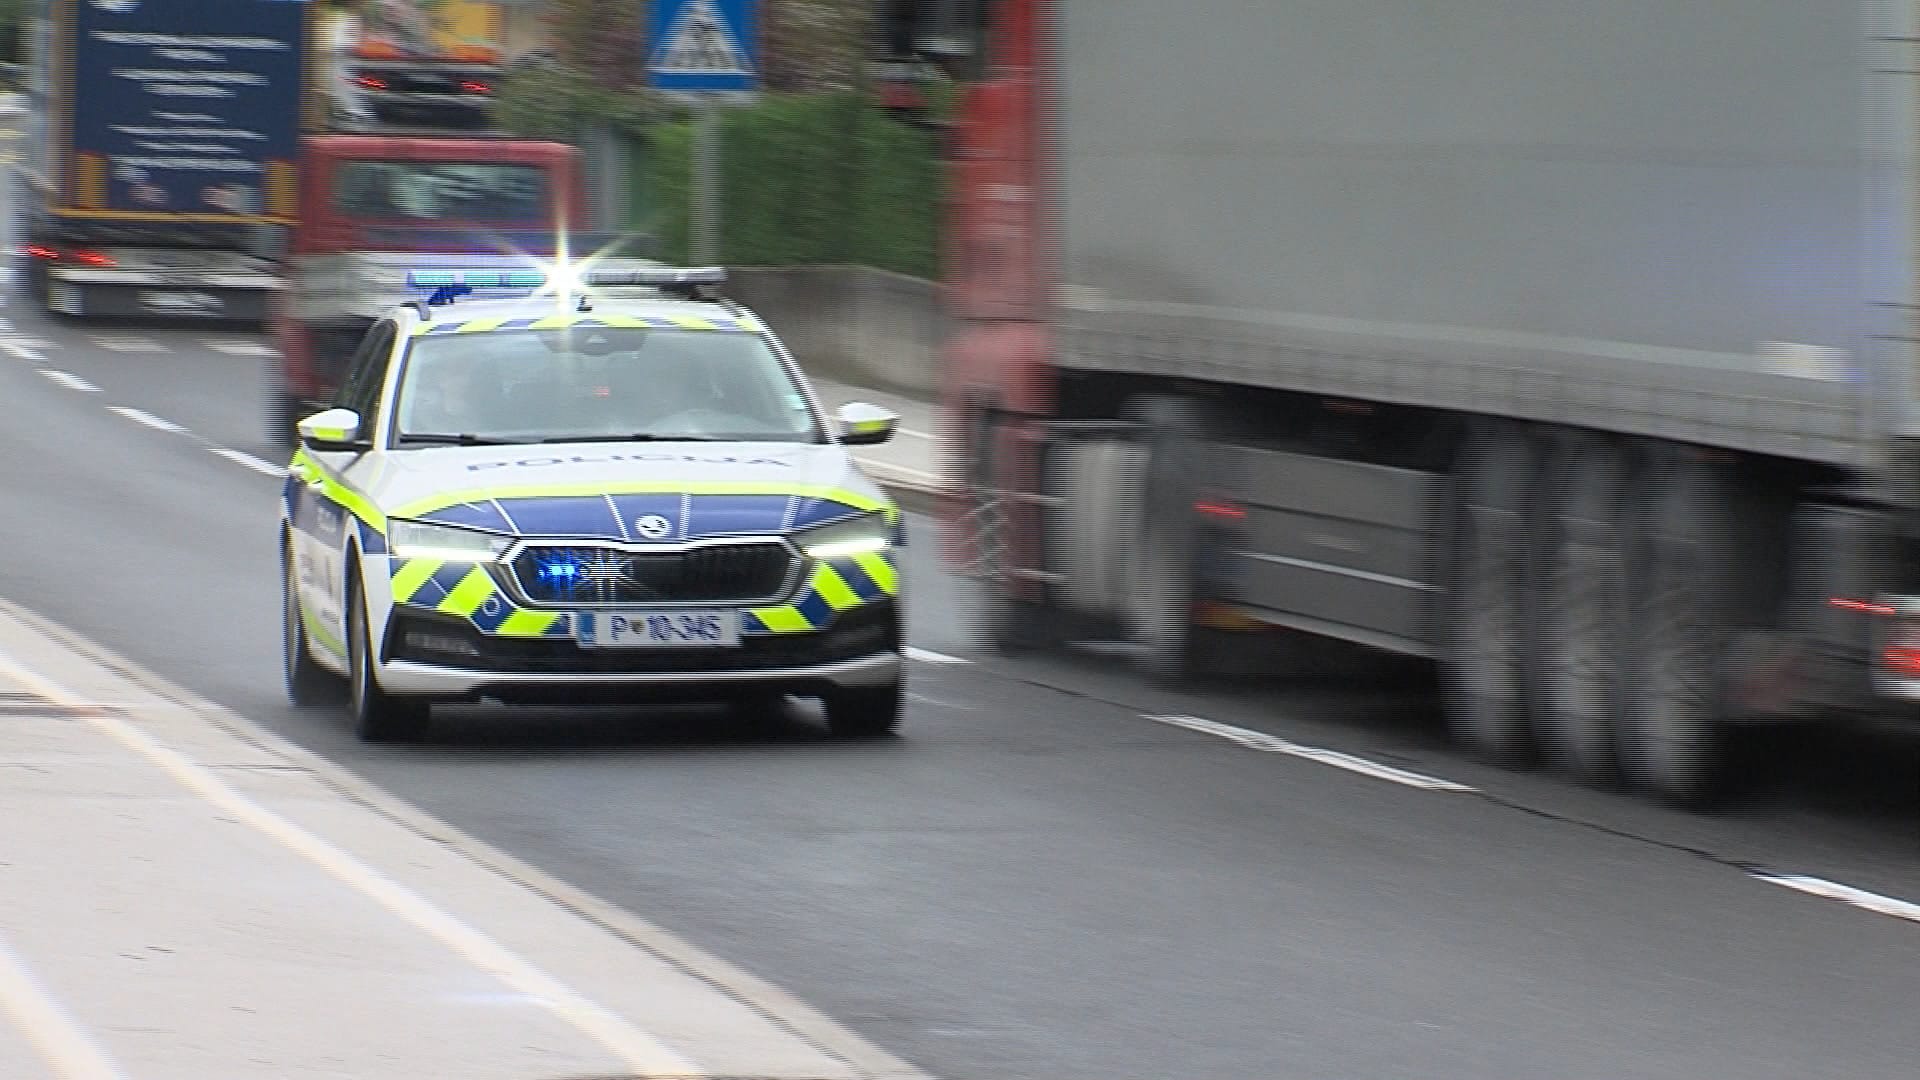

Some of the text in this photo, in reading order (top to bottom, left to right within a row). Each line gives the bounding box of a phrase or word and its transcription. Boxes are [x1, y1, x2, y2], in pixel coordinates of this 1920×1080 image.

[466, 454, 794, 472] POLICIJA
[610, 615, 628, 641] P
[646, 615, 722, 641] 10-345
